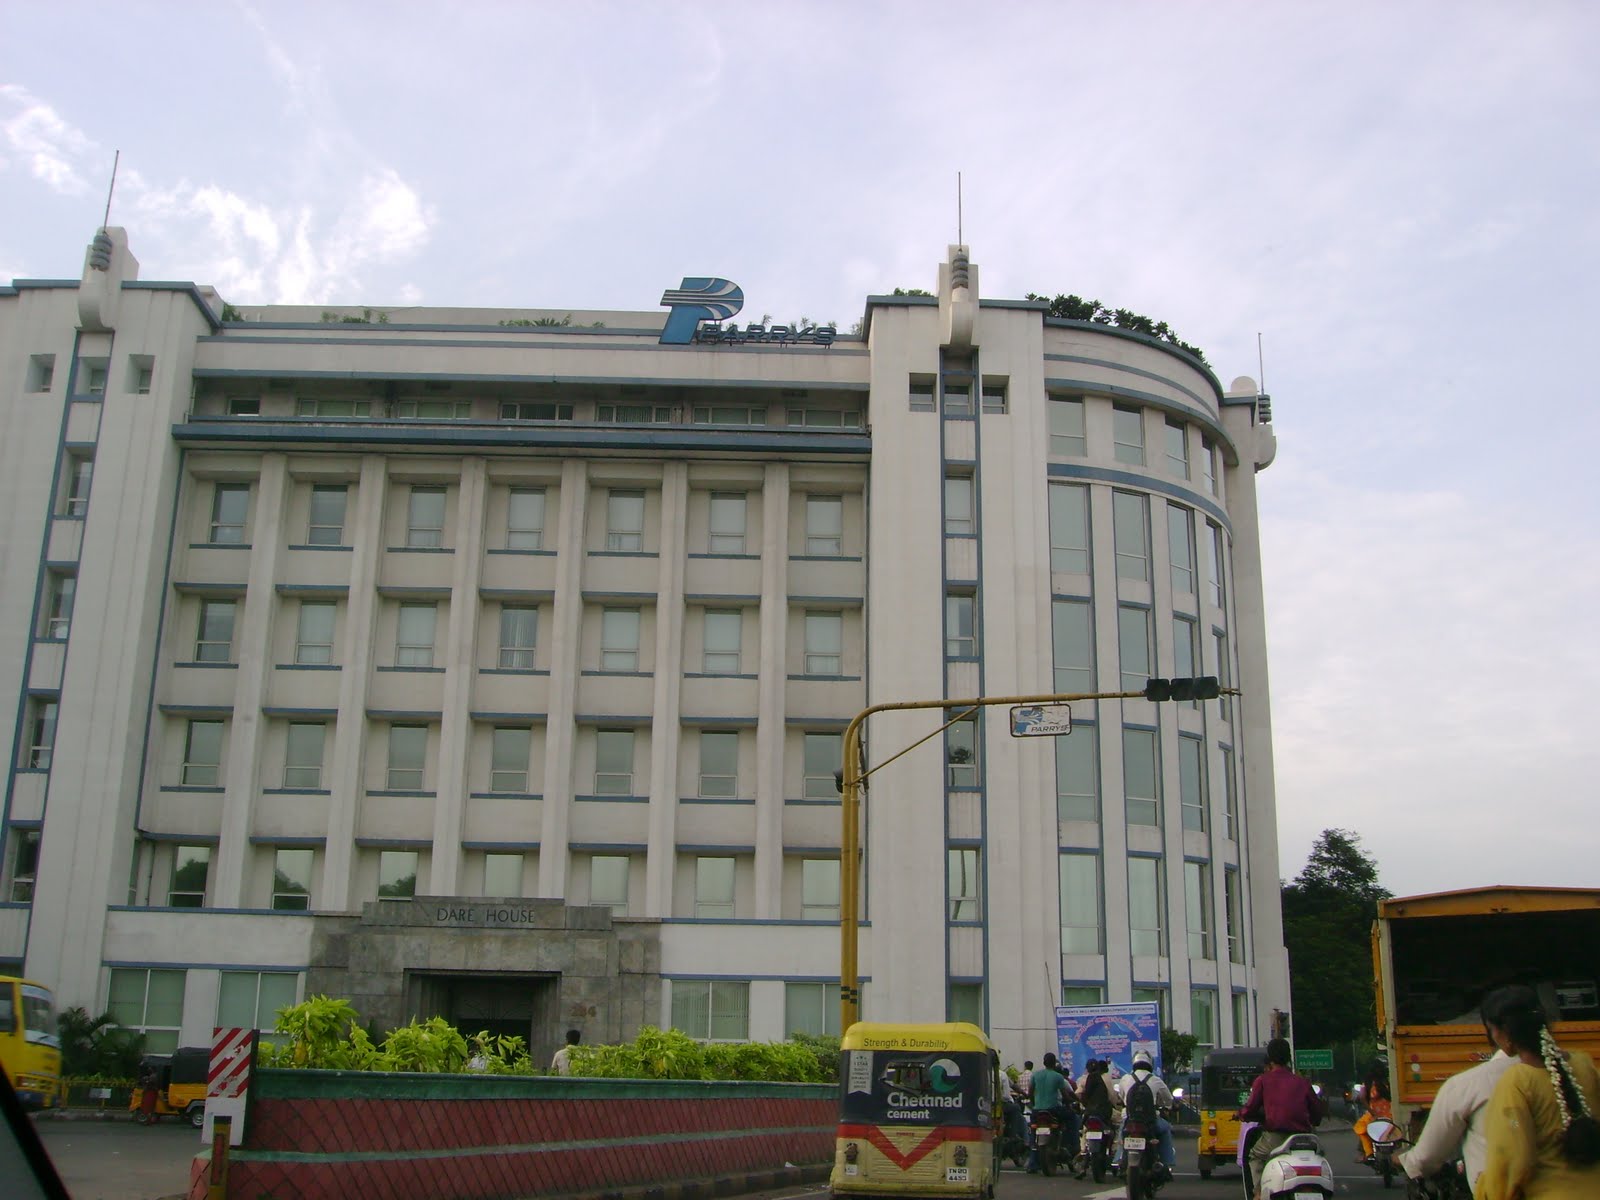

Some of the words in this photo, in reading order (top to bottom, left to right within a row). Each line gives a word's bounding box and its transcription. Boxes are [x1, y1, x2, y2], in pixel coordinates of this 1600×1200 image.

[700, 323, 837, 345] PARRYS
[1031, 724, 1068, 732] PARRYS
[437, 907, 475, 922] DARE
[485, 908, 536, 924] HOUSE
[863, 1038, 899, 1049] Strength
[901, 1039, 908, 1047] &
[909, 1039, 949, 1049] Durability
[887, 1092, 962, 1108] Chettinad
[887, 1109, 930, 1119] cement
